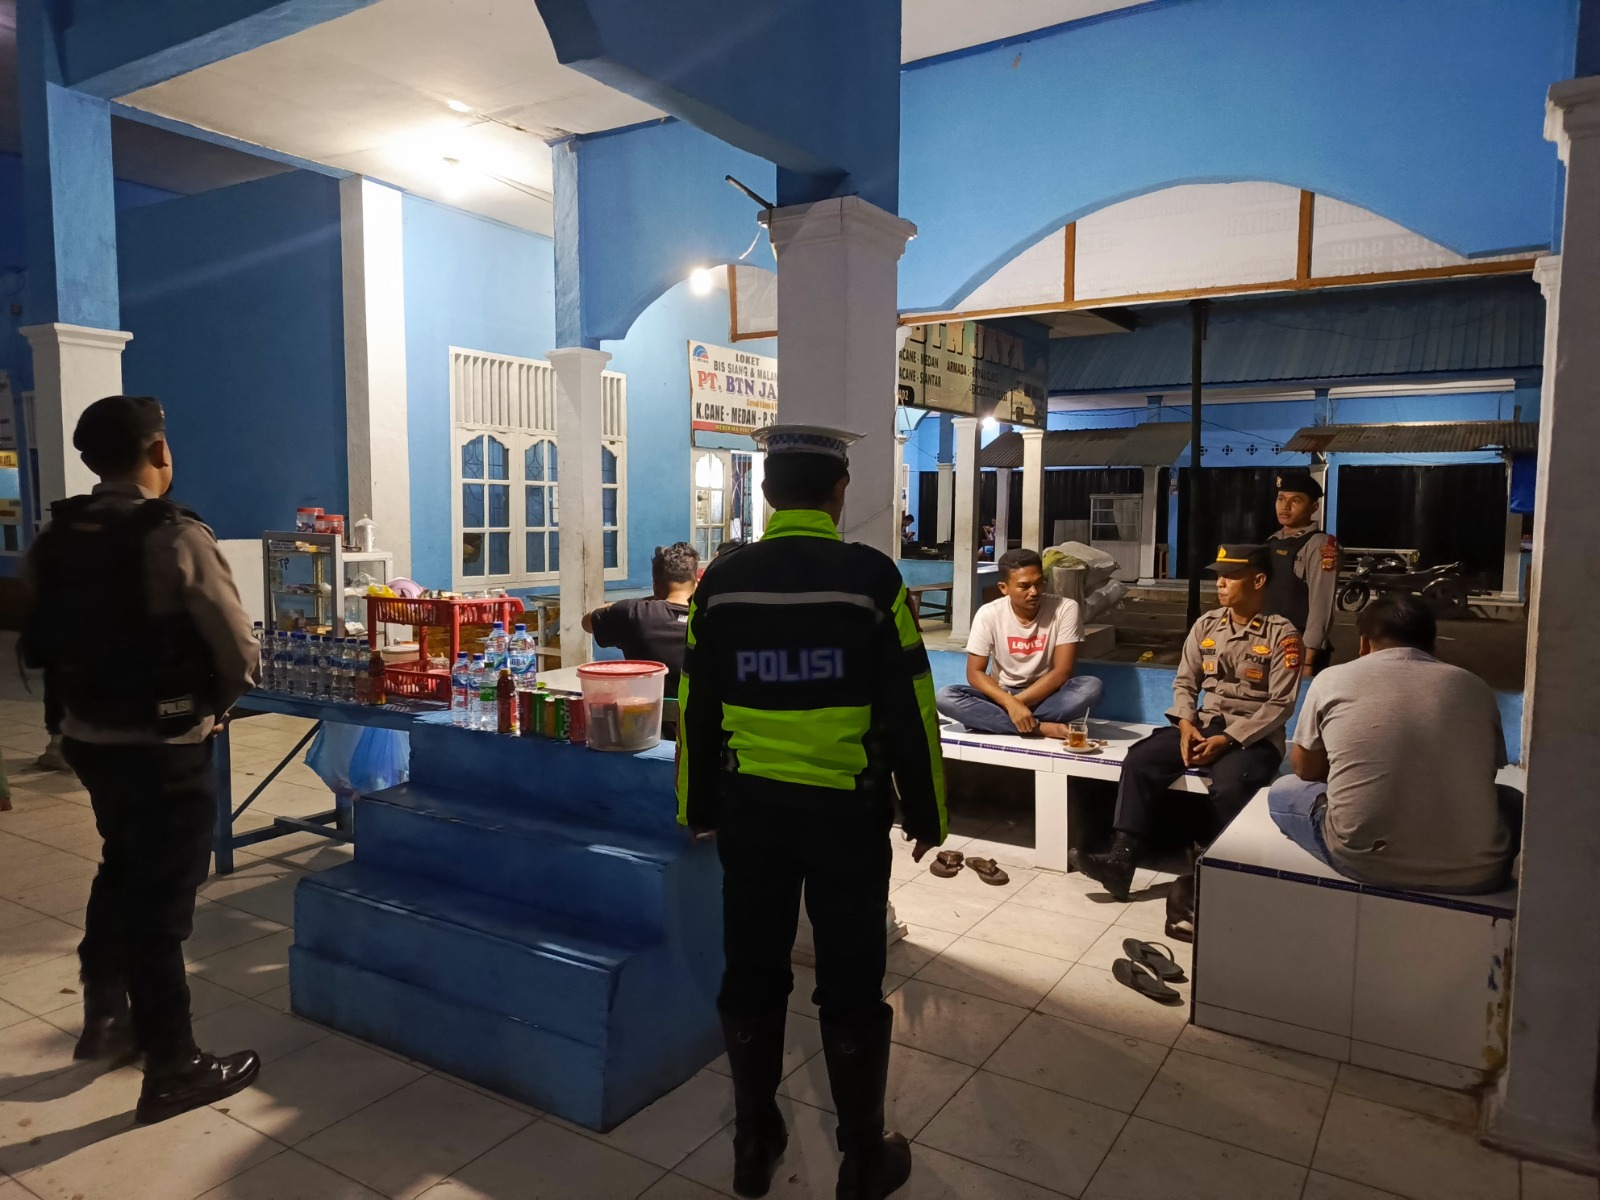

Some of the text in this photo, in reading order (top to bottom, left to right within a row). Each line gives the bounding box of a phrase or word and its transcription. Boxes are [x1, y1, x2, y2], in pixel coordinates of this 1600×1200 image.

[713, 360, 726, 373] BIS
[727, 363, 748, 377] SIANG
[735, 353, 760, 366] LOKET
[946, 360, 967, 376] ARMADA
[697, 370, 722, 392] PT.
[725, 375, 755, 397] BTN
[696, 402, 725, 422] K.CANE
[731, 407, 757, 426] MEDAN
[736, 648, 844, 682] POLISI
